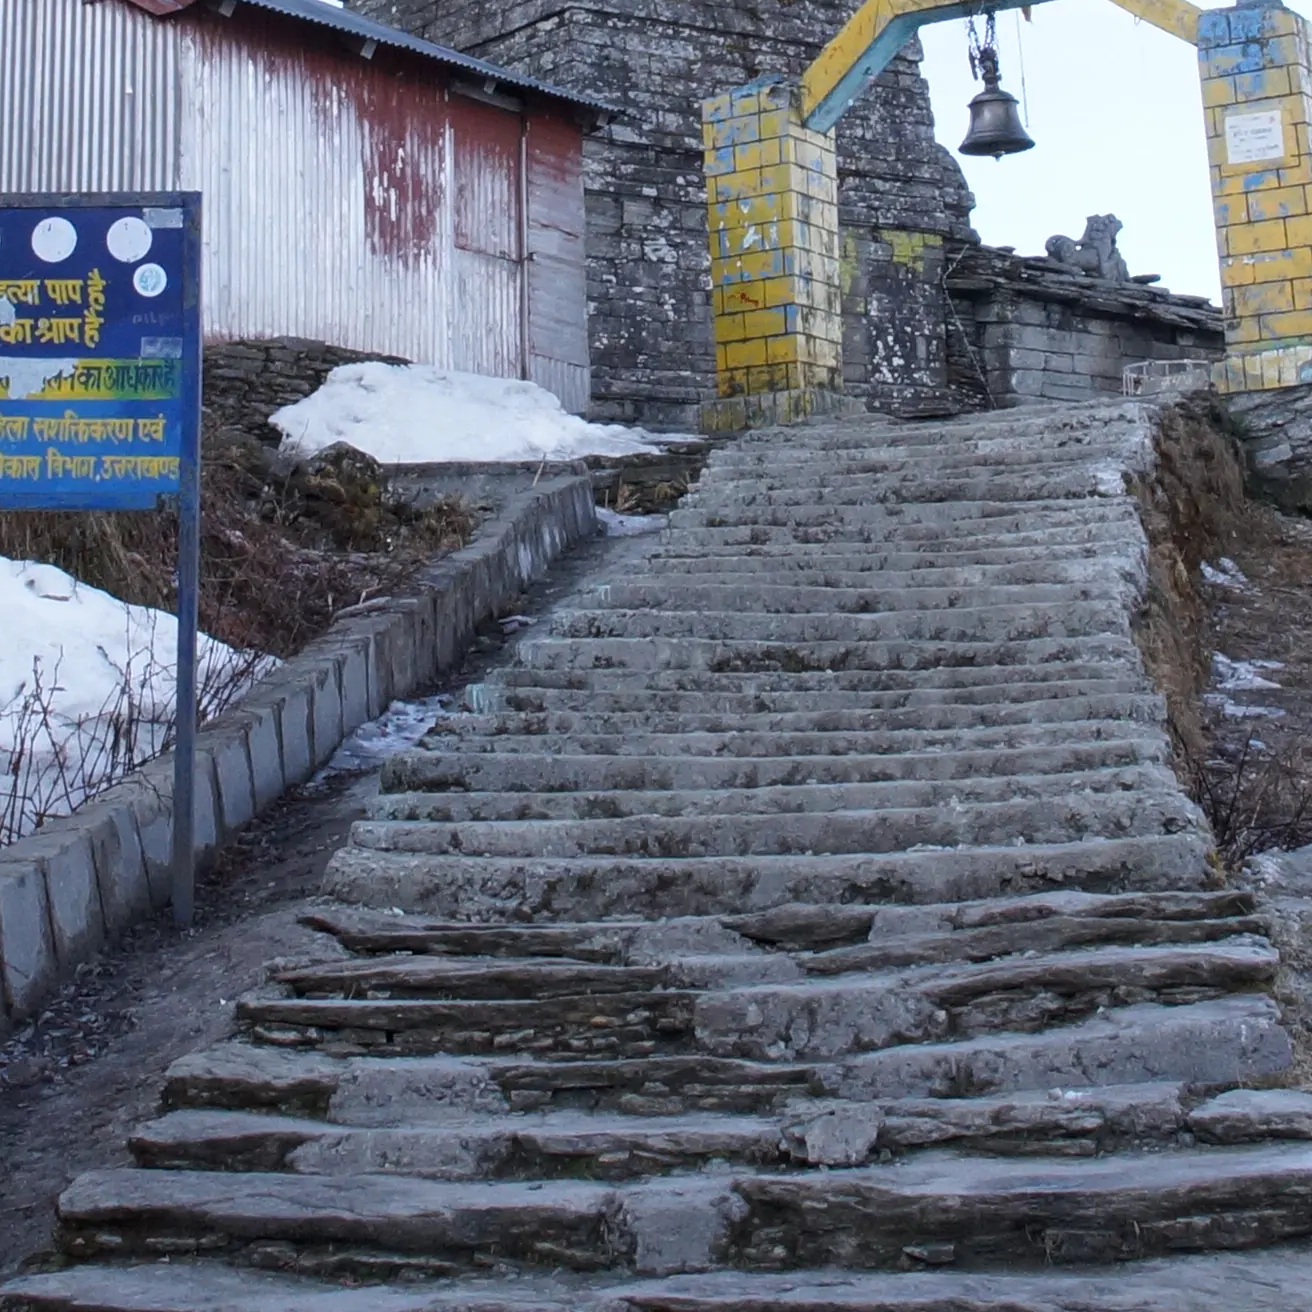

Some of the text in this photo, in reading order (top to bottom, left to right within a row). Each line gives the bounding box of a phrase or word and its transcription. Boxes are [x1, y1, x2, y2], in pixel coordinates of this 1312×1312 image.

[44, 280, 84, 305] पाप
[87, 268, 106, 311] है
[35, 318, 82, 344] श्राप
[84, 308, 105, 348] है
[137, 413, 167, 442] एवं
